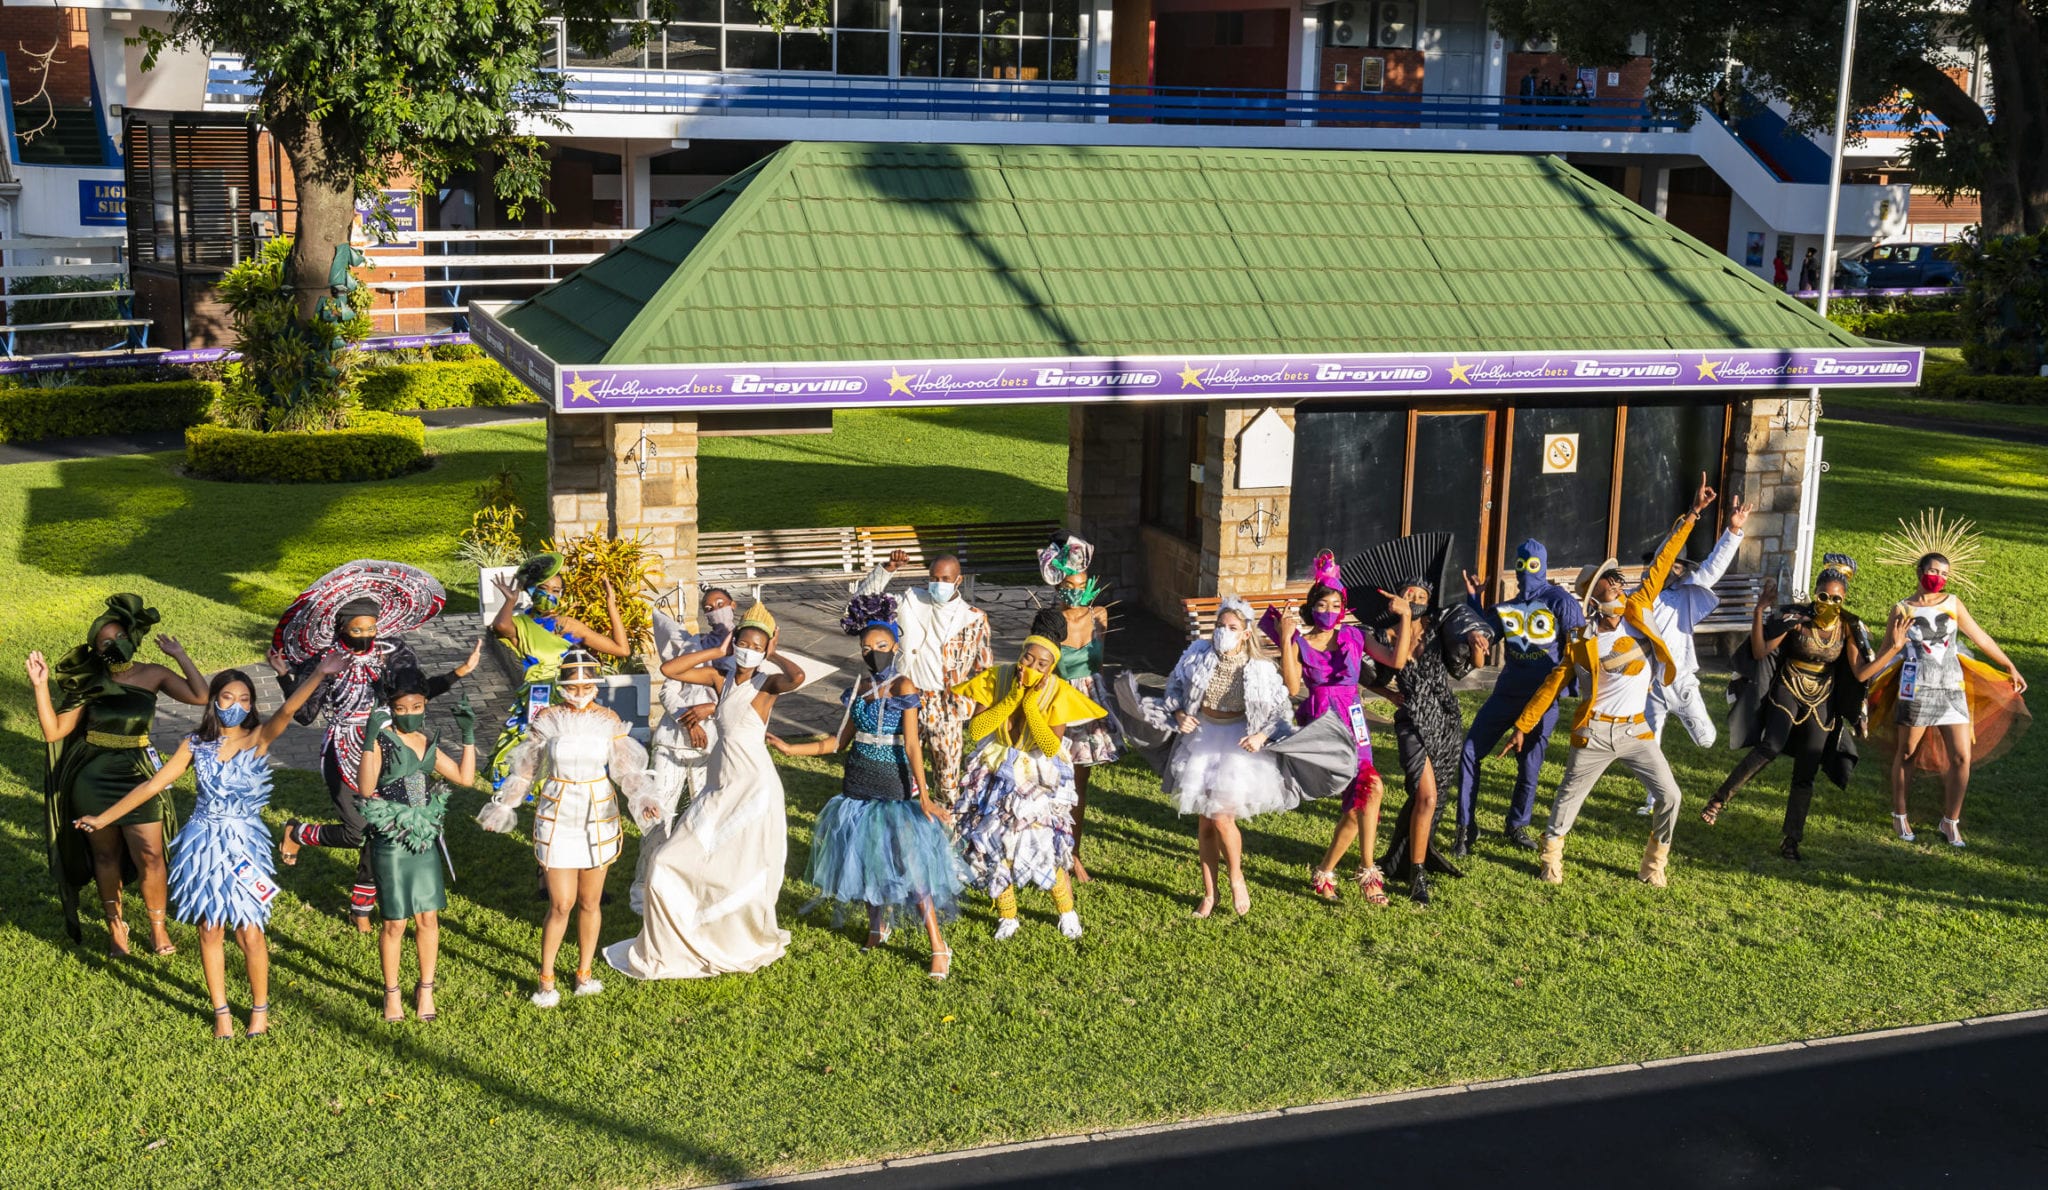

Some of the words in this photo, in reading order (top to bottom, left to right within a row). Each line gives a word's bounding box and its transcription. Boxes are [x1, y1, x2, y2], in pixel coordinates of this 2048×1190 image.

[1312, 363, 1429, 383] Greyville
[1571, 359, 1679, 378] Greyville
[1811, 357, 1909, 376] Greyville
[725, 374, 863, 395] Greyville
[1031, 368, 1157, 387] Greyville
[255, 881, 267, 892] 6
